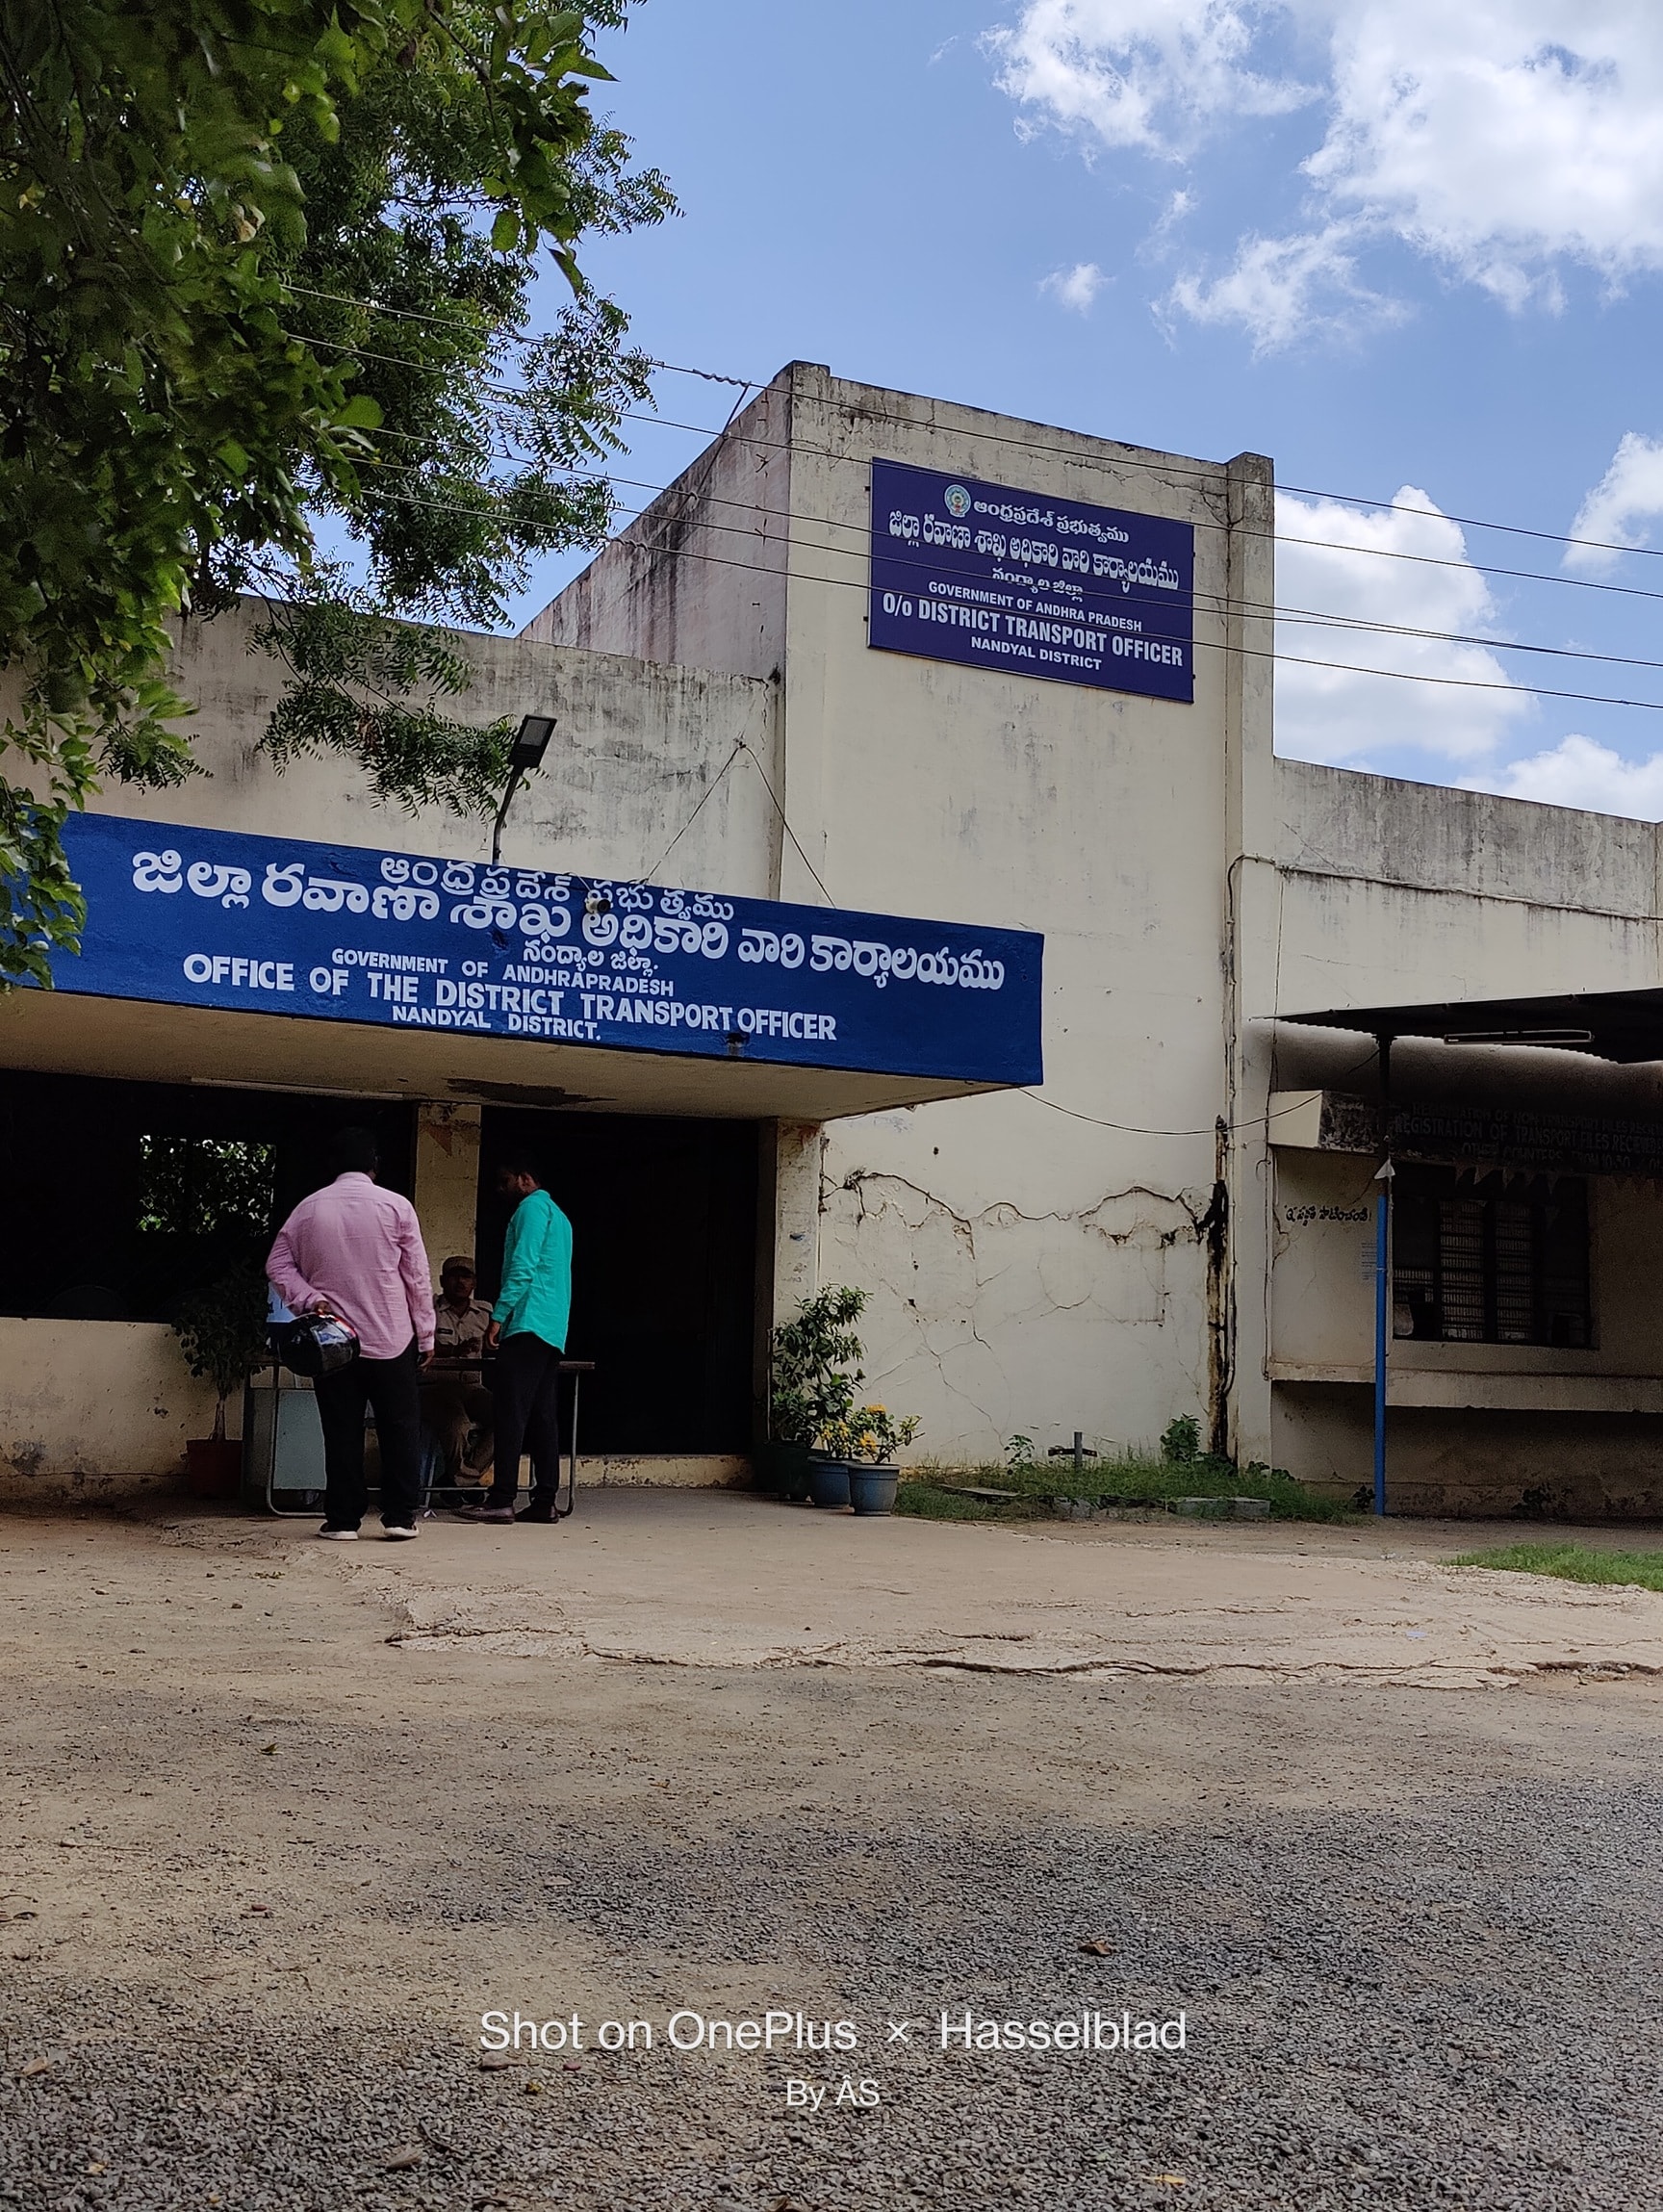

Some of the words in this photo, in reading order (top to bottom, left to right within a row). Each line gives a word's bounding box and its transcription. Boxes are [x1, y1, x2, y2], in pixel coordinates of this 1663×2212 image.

[1057, 515, 1129, 544] ప్రభుత్వము
[889, 510, 920, 548] జిల్లా
[923, 513, 971, 550] రవాణా
[1011, 537, 1060, 568] అధికారి
[1062, 547, 1089, 574] వారి
[1092, 553, 1179, 593] కార్యాలయము
[929, 581, 1014, 607] GOVERNMENT
[1016, 598, 1033, 610] OF
[1036, 602, 1086, 622] ANDHRA
[1088, 611, 1142, 632] PRADESH
[918, 599, 1000, 632] DISTRICT
[1005, 615, 1107, 653] TRANSPORT
[1112, 635, 1183, 667] OFFICER
[971, 636, 1036, 658] NANDYAL
[1039, 648, 1102, 671] DISTRICT
[132, 850, 252, 910] జిల్లా
[261, 862, 441, 922] రవాణా
[449, 895, 573, 944] శాఖ
[581, 913, 729, 960] అధికారి
[737, 928, 806, 969] వారి
[809, 934, 1006, 990] కార్యాలయము
[331, 948, 448, 974] GOVERNMENT
[461, 961, 489, 978] OF
[523, 939, 605, 972] నంద్యాల
[183, 952, 295, 991] OFFICE
[309, 966, 349, 996] OF
[367, 972, 419, 1004] THE
[436, 979, 565, 1016] DISTRICT
[580, 992, 733, 1031] TRANSPORT
[737, 1008, 837, 1041] OFFICER
[392, 1006, 492, 1029] NANDYAL
[507, 1014, 601, 1042] DISTRICT.
[1490, 1122, 1509, 1142] OF
